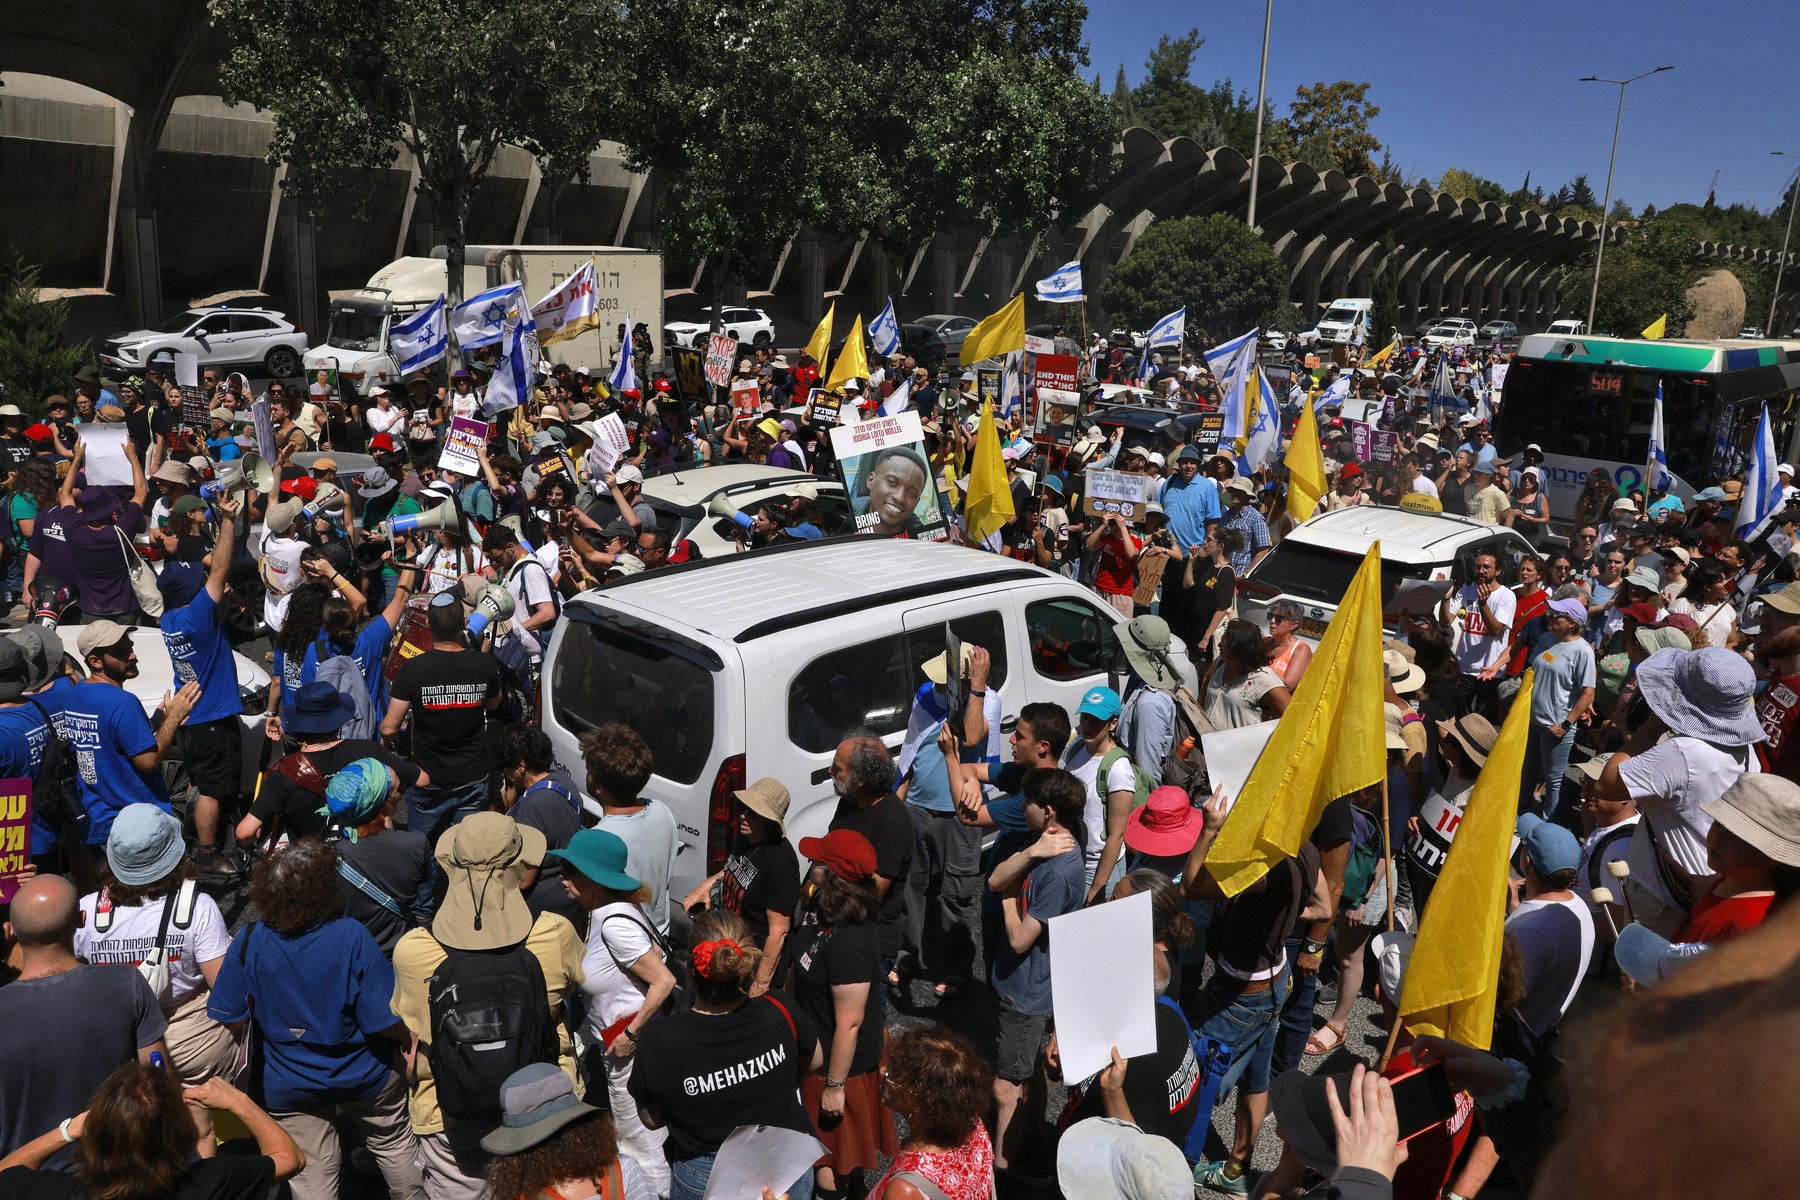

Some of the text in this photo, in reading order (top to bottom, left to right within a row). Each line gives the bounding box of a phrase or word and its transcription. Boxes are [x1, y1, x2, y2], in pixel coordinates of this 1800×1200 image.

[711, 336, 735, 359] STOP
[1037, 371, 1075, 382] END THIS
[1591, 372, 1621, 393] 504
[452, 429, 483, 446] המדינה
[855, 511, 880, 529] BRING
[421, 685, 445, 695] להחזרת
[446, 684, 475, 694] המשפחות
[422, 693, 456, 706] והנעדרים
[91, 934, 184, 952] מטה משפחות להחזרת
[683, 1043, 786, 1096] @MEHAZKIM
